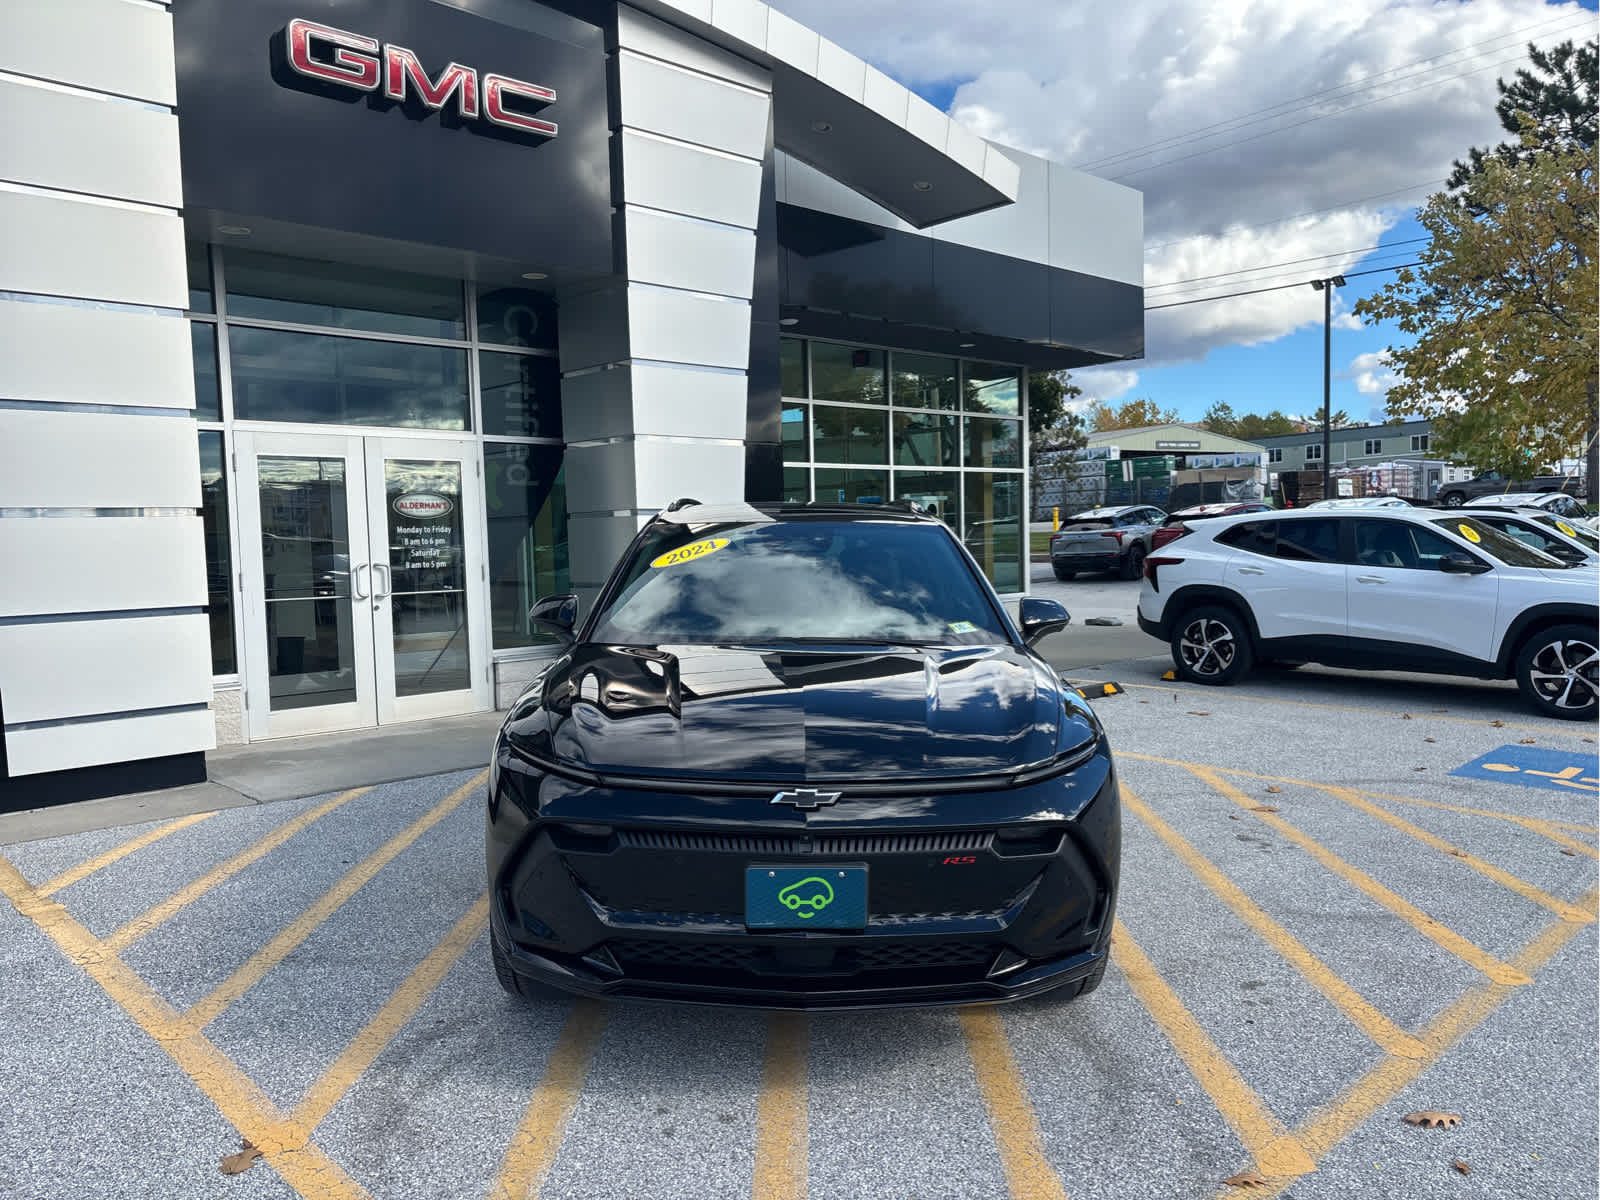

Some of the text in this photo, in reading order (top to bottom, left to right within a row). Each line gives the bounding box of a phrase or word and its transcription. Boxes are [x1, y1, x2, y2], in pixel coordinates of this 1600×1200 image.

[287, 17, 559, 138] GMC
[396, 525, 451, 535] Monday to Friday
[410, 548, 440, 557] Saturday
[666, 541, 716, 564] 2024
[436, 561, 447, 569] pm
[942, 855, 977, 865] RS
